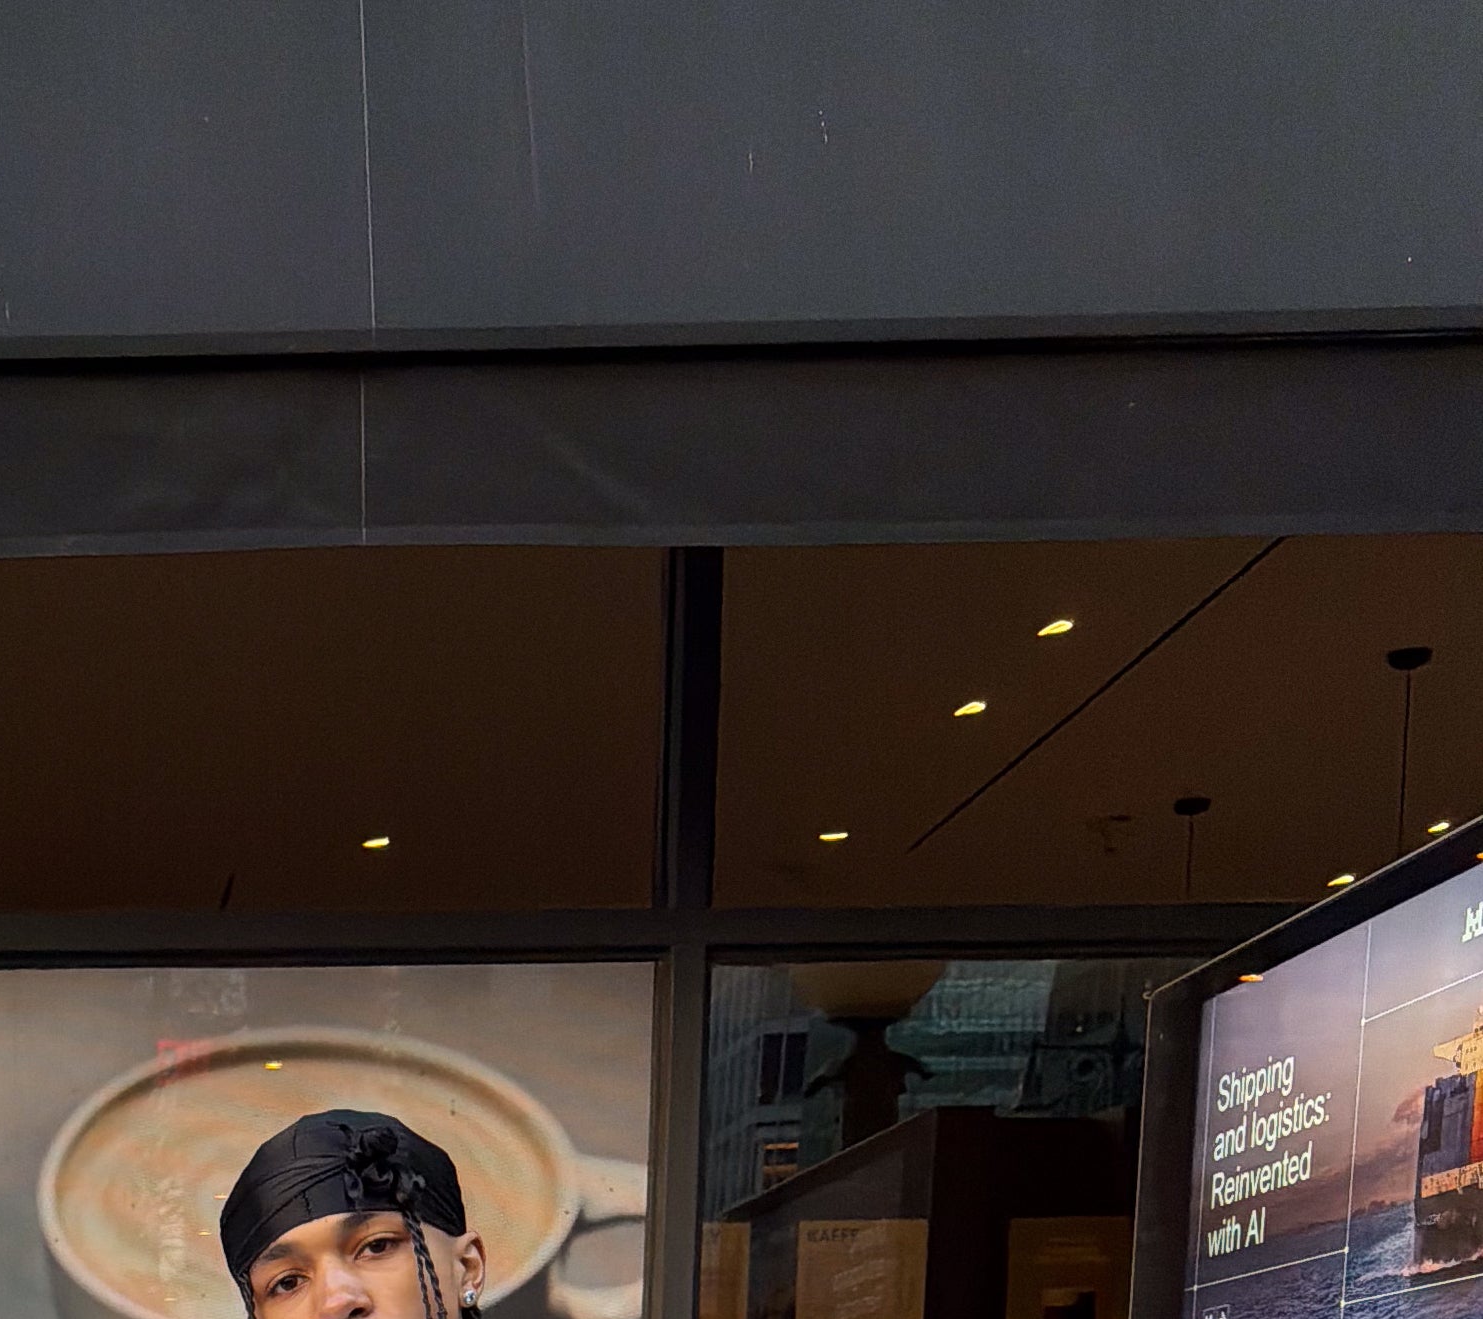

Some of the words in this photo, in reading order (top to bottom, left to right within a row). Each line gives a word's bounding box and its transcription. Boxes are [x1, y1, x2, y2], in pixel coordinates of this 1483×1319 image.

[1217, 1056, 1294, 1113] Shipping
[1214, 1114, 1247, 1161] and
[1251, 1092, 1331, 1151] logistics:
[1210, 1140, 1313, 1210] Reinvented
[1208, 1214, 1241, 1258] with
[1245, 1206, 1266, 1248] AI
